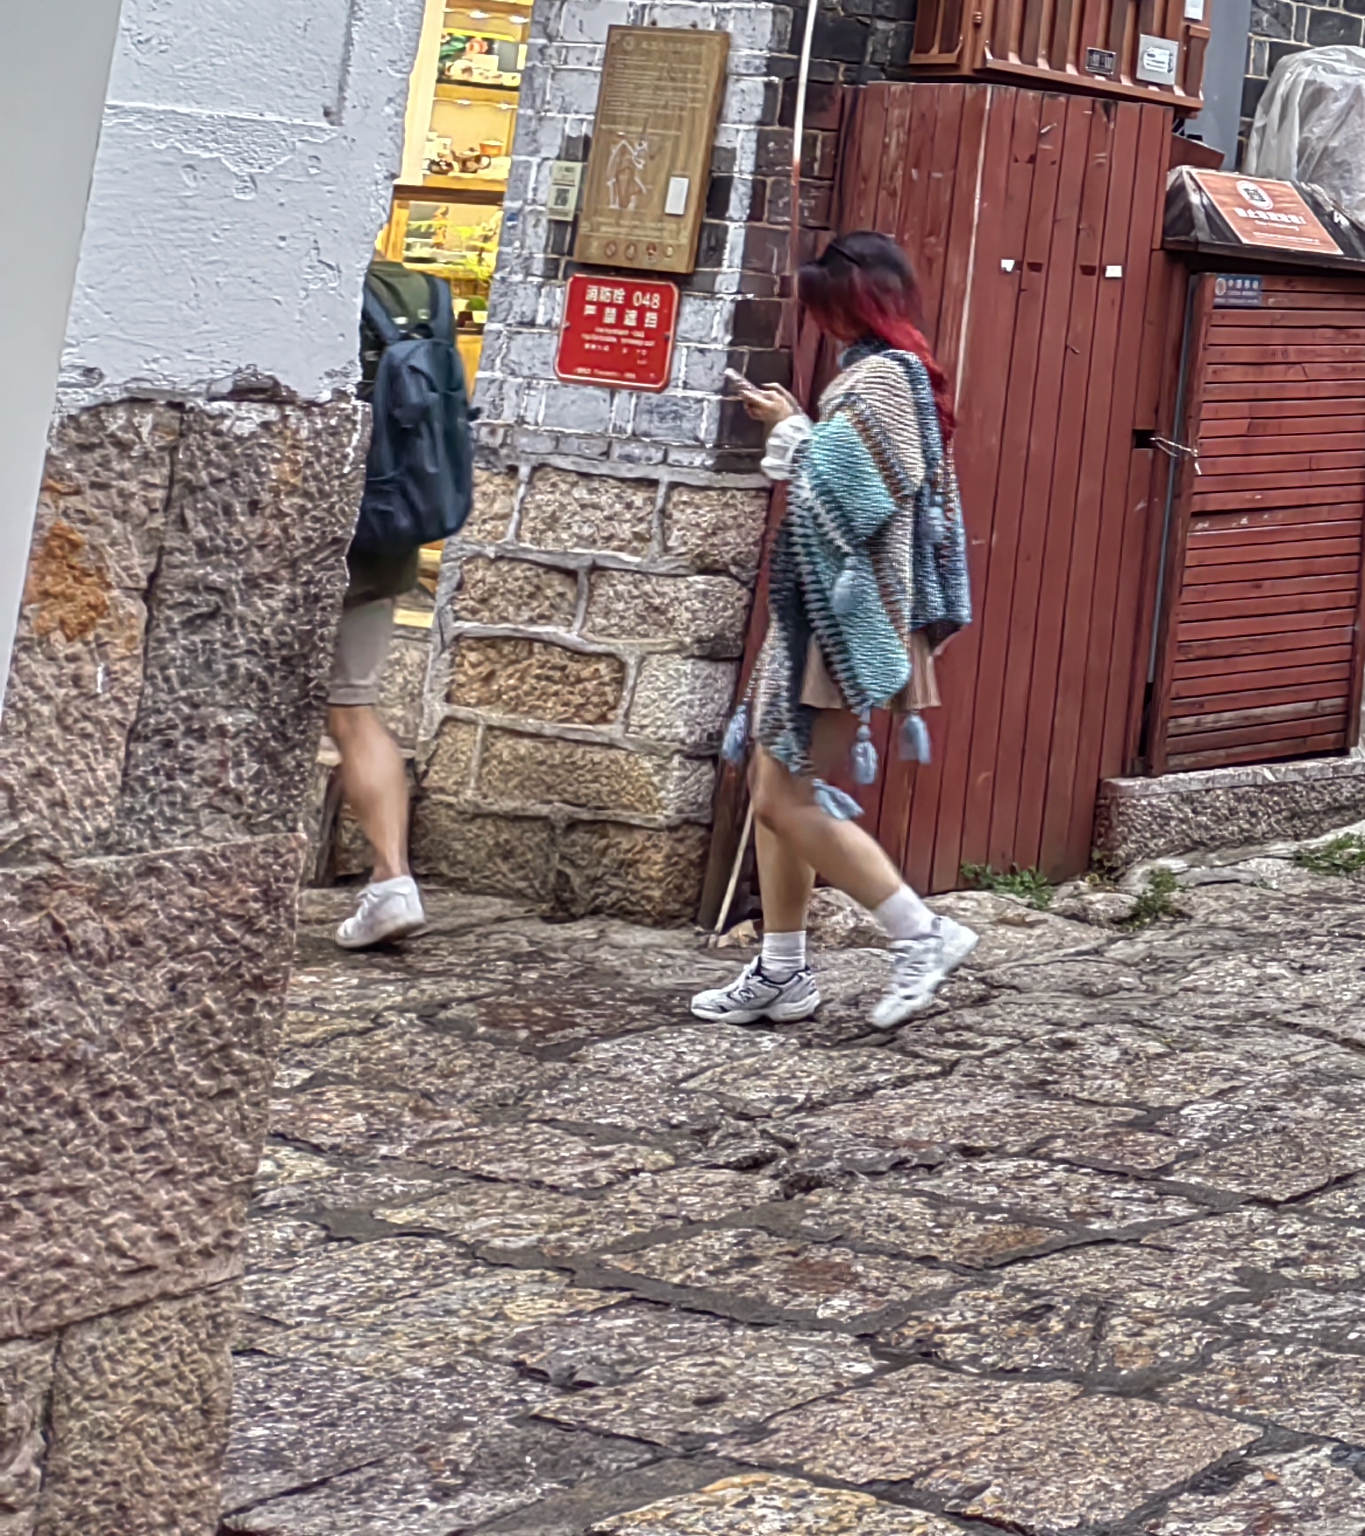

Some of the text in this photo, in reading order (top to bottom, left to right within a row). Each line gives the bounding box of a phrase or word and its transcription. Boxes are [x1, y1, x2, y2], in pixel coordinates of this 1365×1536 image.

[585, 284, 660, 309] 消防栓 048
